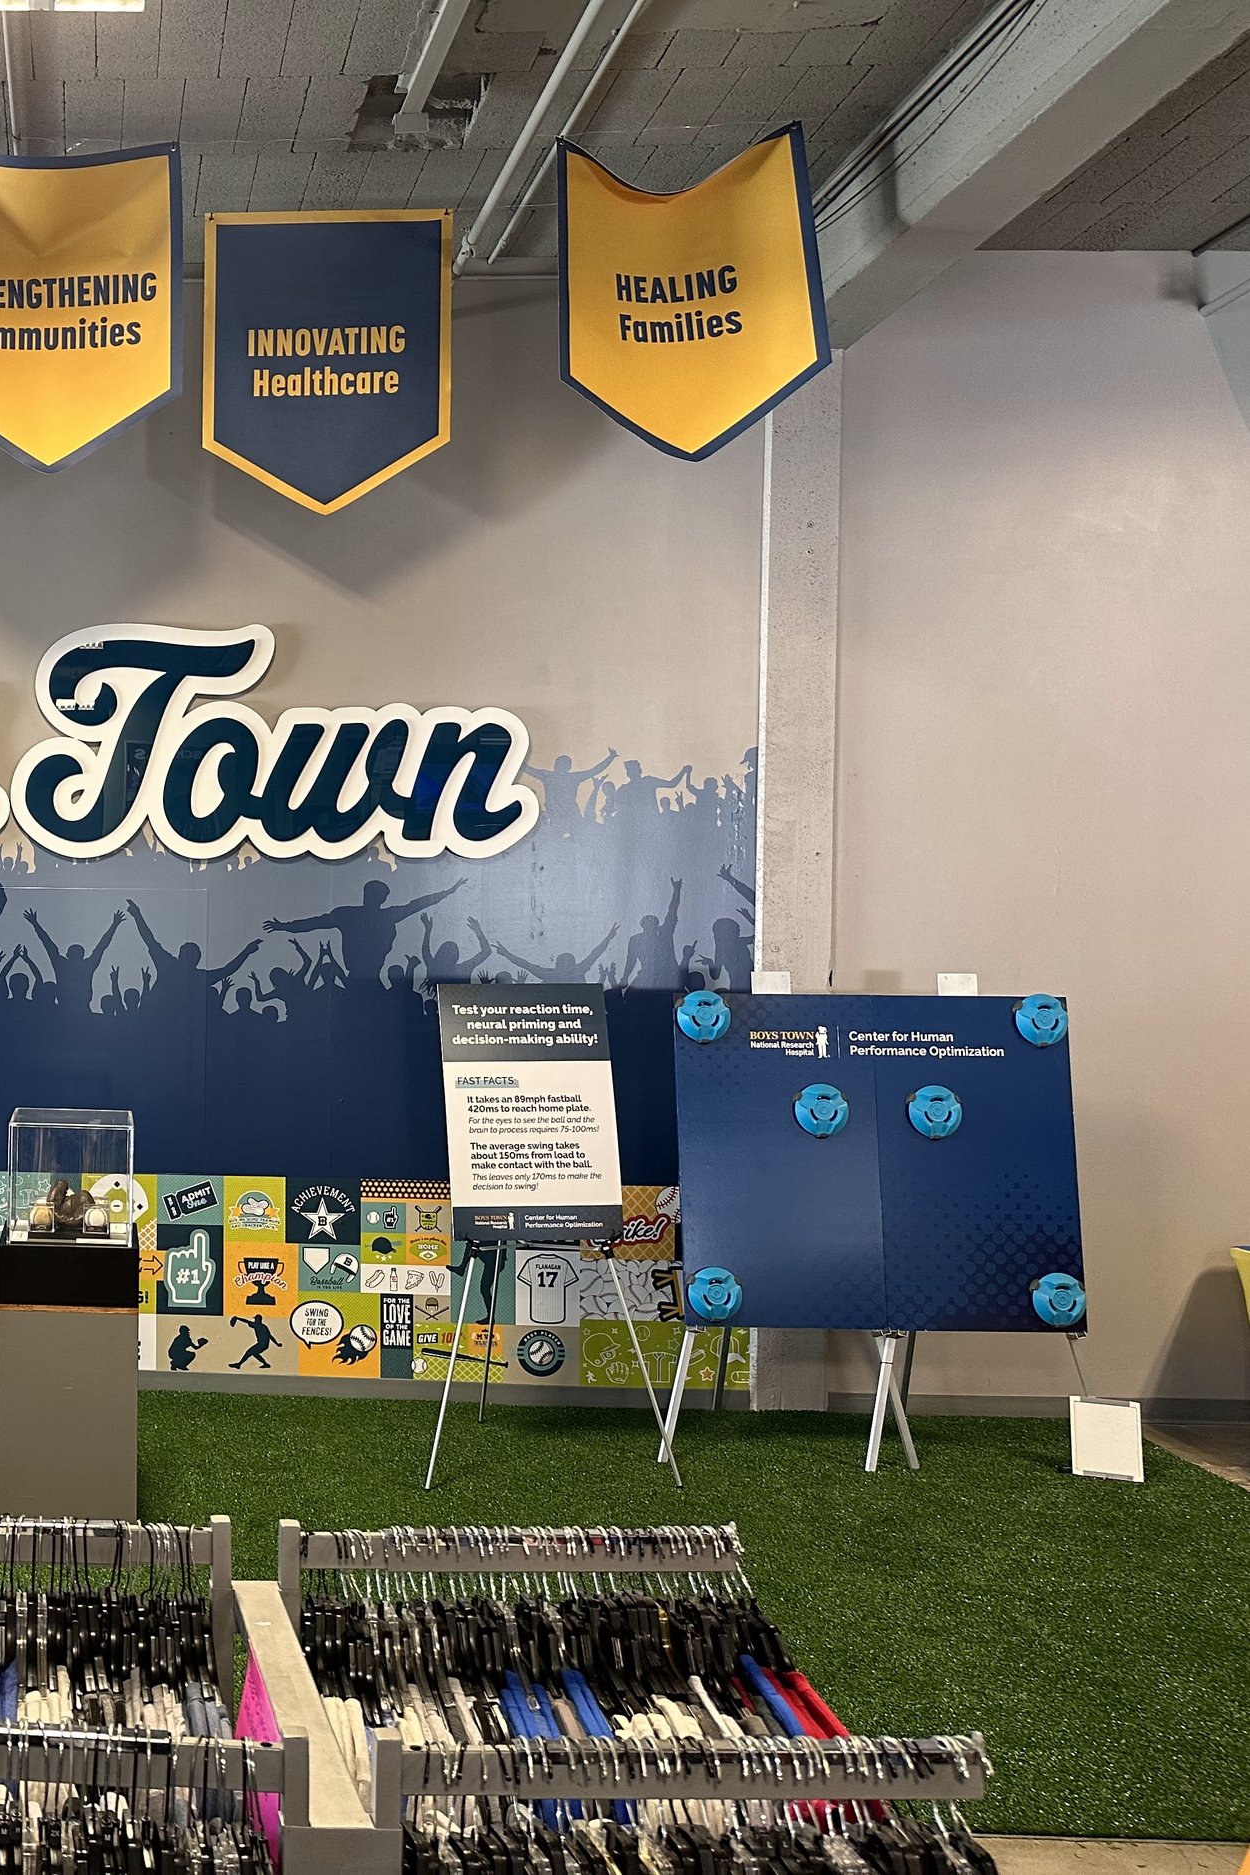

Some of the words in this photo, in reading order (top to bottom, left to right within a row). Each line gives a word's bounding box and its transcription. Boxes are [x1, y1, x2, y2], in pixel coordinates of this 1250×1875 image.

[616, 265, 737, 305] HEALING
[619, 310, 743, 344] Families
[248, 325, 405, 357] INNOVATING
[254, 366, 399, 397] Healthcare
[12, 624, 538, 859] Town
[452, 1005, 479, 1015] Test
[480, 1007, 507, 1017] your
[510, 1004, 560, 1014] reaction
[562, 1004, 593, 1015] time,
[467, 1019, 507, 1030] neural
[509, 1019, 556, 1032] priming
[558, 1019, 581, 1029] and
[452, 1033, 553, 1047] decision-making
[556, 1033, 598, 1046] ability!
[750, 1031, 778, 1040] BOYS
[780, 1031, 814, 1040] TOWN
[849, 1031, 890, 1042] Center
[892, 1031, 909, 1042] for
[911, 1031, 953, 1042] Human
[750, 1041, 780, 1049] National
[781, 1041, 814, 1051] Research
[785, 1049, 815, 1057] Hospital
[850, 1045, 927, 1056] Performance
[929, 1046, 1004, 1059] Optimization
[458, 1077, 481, 1085] FAST
[484, 1077, 516, 1085] FACTS:
[476, 1095, 500, 1103] takes
[514, 1095, 546, 1104] 89mph
[547, 1094, 582, 1103] fastball
[468, 1105, 499, 1113] 420ms
[501, 1105, 510, 1113] to
[512, 1105, 537, 1113] reach
[539, 1104, 564, 1112] home
[566, 1104, 591, 1114] plate.
[537, 1116, 549, 1124] the
[499, 1127, 528, 1135] process
[529, 1126, 559, 1134] requires
[560, 1125, 600, 1133] 75-100ms!
[470, 1142, 487, 1150] The
[489, 1143, 525, 1152] average
[527, 1142, 553, 1152] swing
[555, 1141, 580, 1150] takes
[471, 1152, 498, 1160] about
[499, 1151, 529, 1159] 150ms
[531, 1151, 552, 1159] from
[554, 1151, 575, 1159] load
[472, 1161, 497, 1169] make
[498, 1161, 533, 1169] contact
[534, 1161, 554, 1169] with
[556, 1160, 571, 1168] the
[488, 1173, 513, 1181] leaves
[514, 1173, 531, 1182] only
[532, 1172, 557, 1180] 170ms
[514, 1182, 539, 1191] swing!
[182, 1187, 210, 1203] ADMIT
[291, 1185, 356, 1213] ACHIEVEMENT
[248, 1261, 258, 1269] PLAY
[270, 1262, 275, 1270] A
[176, 1269, 200, 1285] #1
[310, 1275, 344, 1286] Baseball
[538, 1271, 559, 1288] 17
[304, 1307, 329, 1318] SWING
[383, 1305, 411, 1324] LOVE
[307, 1318, 316, 1326] FOR
[317, 1318, 327, 1326] THE
[301, 1326, 332, 1336] FENCES!
[383, 1330, 411, 1346] GAME
[418, 1334, 437, 1343] GIVE
